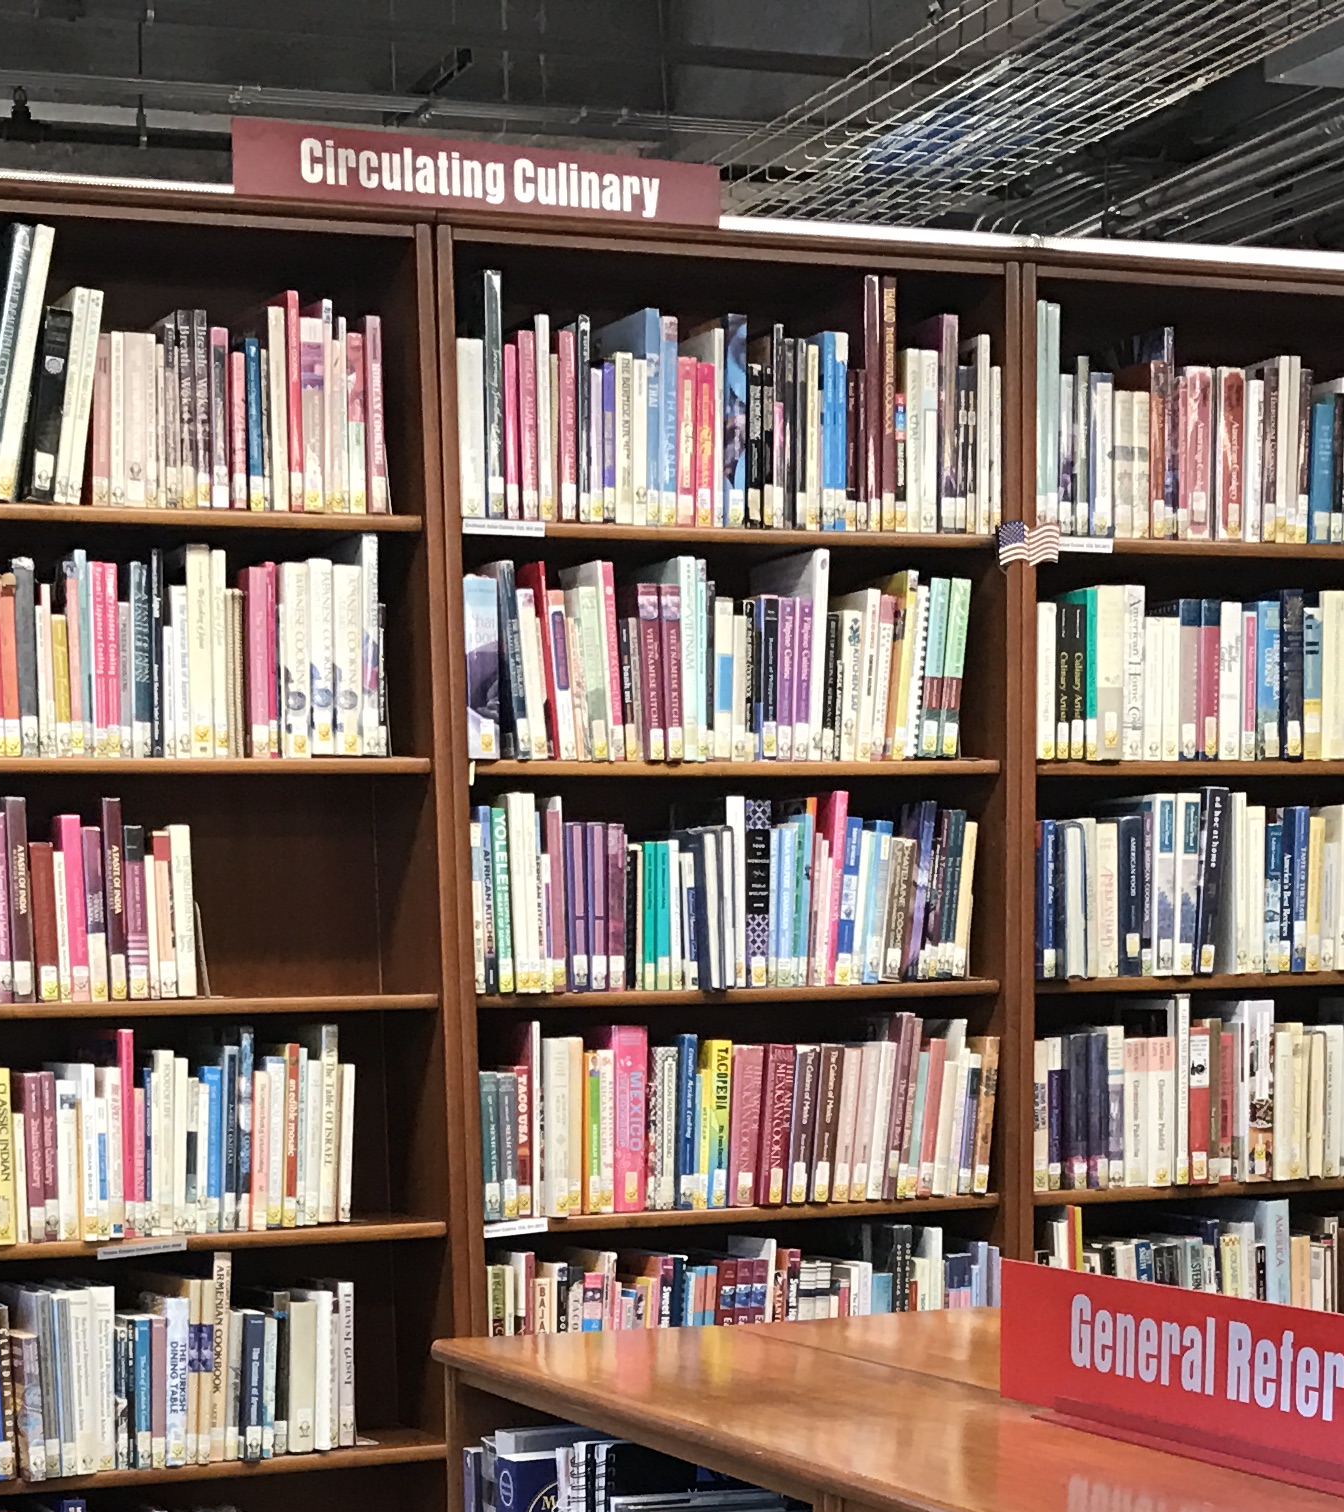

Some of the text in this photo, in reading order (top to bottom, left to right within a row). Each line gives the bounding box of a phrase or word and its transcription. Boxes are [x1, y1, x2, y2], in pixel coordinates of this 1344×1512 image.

[299, 137, 660, 218] Circulating Culinary
[649, 383, 659, 408] THAI
[663, 389, 676, 478] THAILAND
[783, 615, 793, 648] Filipino
[801, 617, 811, 649] Filipino
[622, 665, 632, 703] banh mi
[646, 628, 659, 727] VIETNAMESE KITCHE
[669, 628, 680, 727] VIETNAMESE KITCHE
[17, 851, 26, 876] TASTE
[112, 851, 121, 876] TASTE
[493, 815, 509, 891] YOLELE!
[1129, 837, 1137, 897] AMERICAN FOOD
[1210, 796, 1222, 869] ad hoc at home
[19, 889, 28, 914] INDIA
[115, 889, 123, 914] INDIA
[482, 859, 495, 964] AFRICAN KITCHEN
[1280, 852, 1292, 937] America's Best Recipes
[715, 1047, 730, 1111] TACOPEDIA
[805, 1052, 816, 1065] The
[829, 1051, 838, 1064] The
[288, 1079, 298, 1157] an edible mosaic
[517, 1074, 529, 1145] TACO USA
[628, 1071, 644, 1152] MEXICO
[665, 1063, 674, 1159] MEXICAN FAMILY COOKING
[801, 1101, 812, 1125] Mexico
[825, 1100, 835, 1123] Mexico
[1275, 1214, 1286, 1267] AMERICA
[212, 1265, 225, 1394] ARMENIAN COOKBOOK
[1070, 1293, 1217, 1396] General
[169, 1341, 179, 1414] DINING TABLE
[178, 1343, 187, 1412] THE TURKISH
